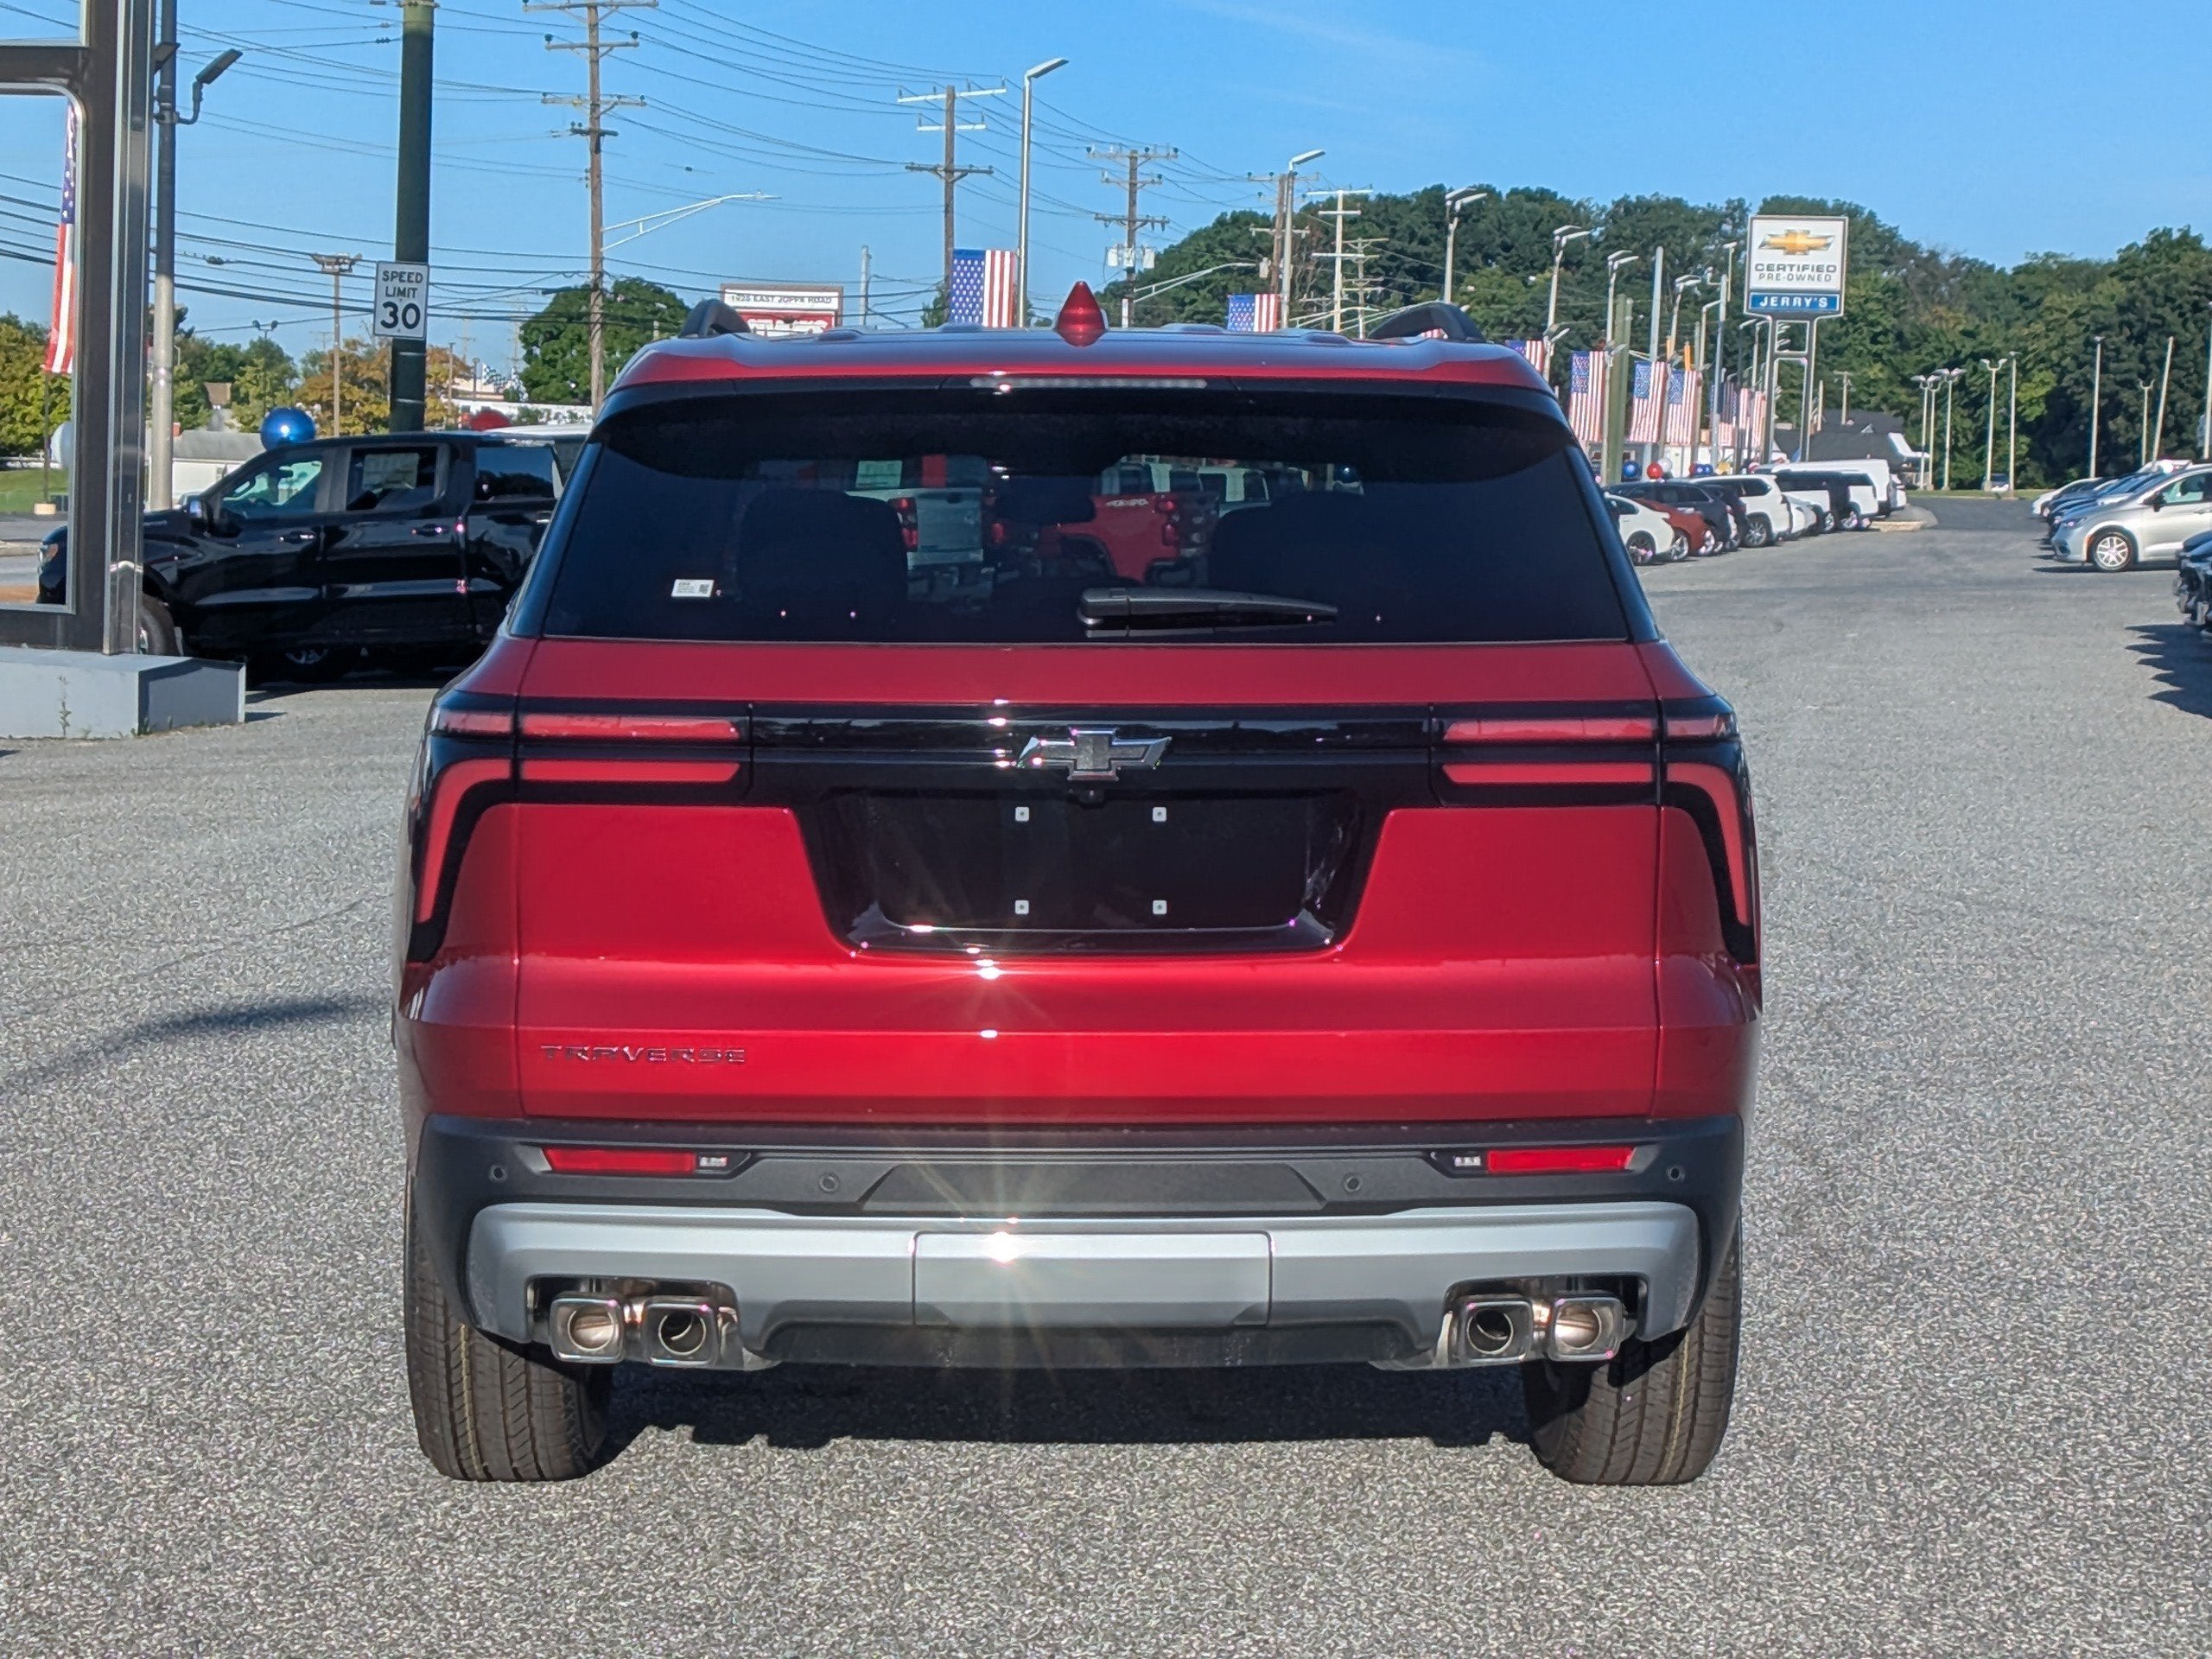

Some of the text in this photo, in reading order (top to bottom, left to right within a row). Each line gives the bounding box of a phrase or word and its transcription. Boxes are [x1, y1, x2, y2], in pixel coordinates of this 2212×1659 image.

[1755, 263, 1837, 273] CERTIFIED
[382, 270, 423, 283] SPEED
[1758, 272, 1832, 283] PRE-OWNED
[385, 286, 418, 299] LIMIT
[753, 294, 774, 303] EAST
[1759, 296, 1828, 308] JERRY'S
[380, 301, 421, 329] 30
[541, 1046, 745, 1063] TRAVERSE
